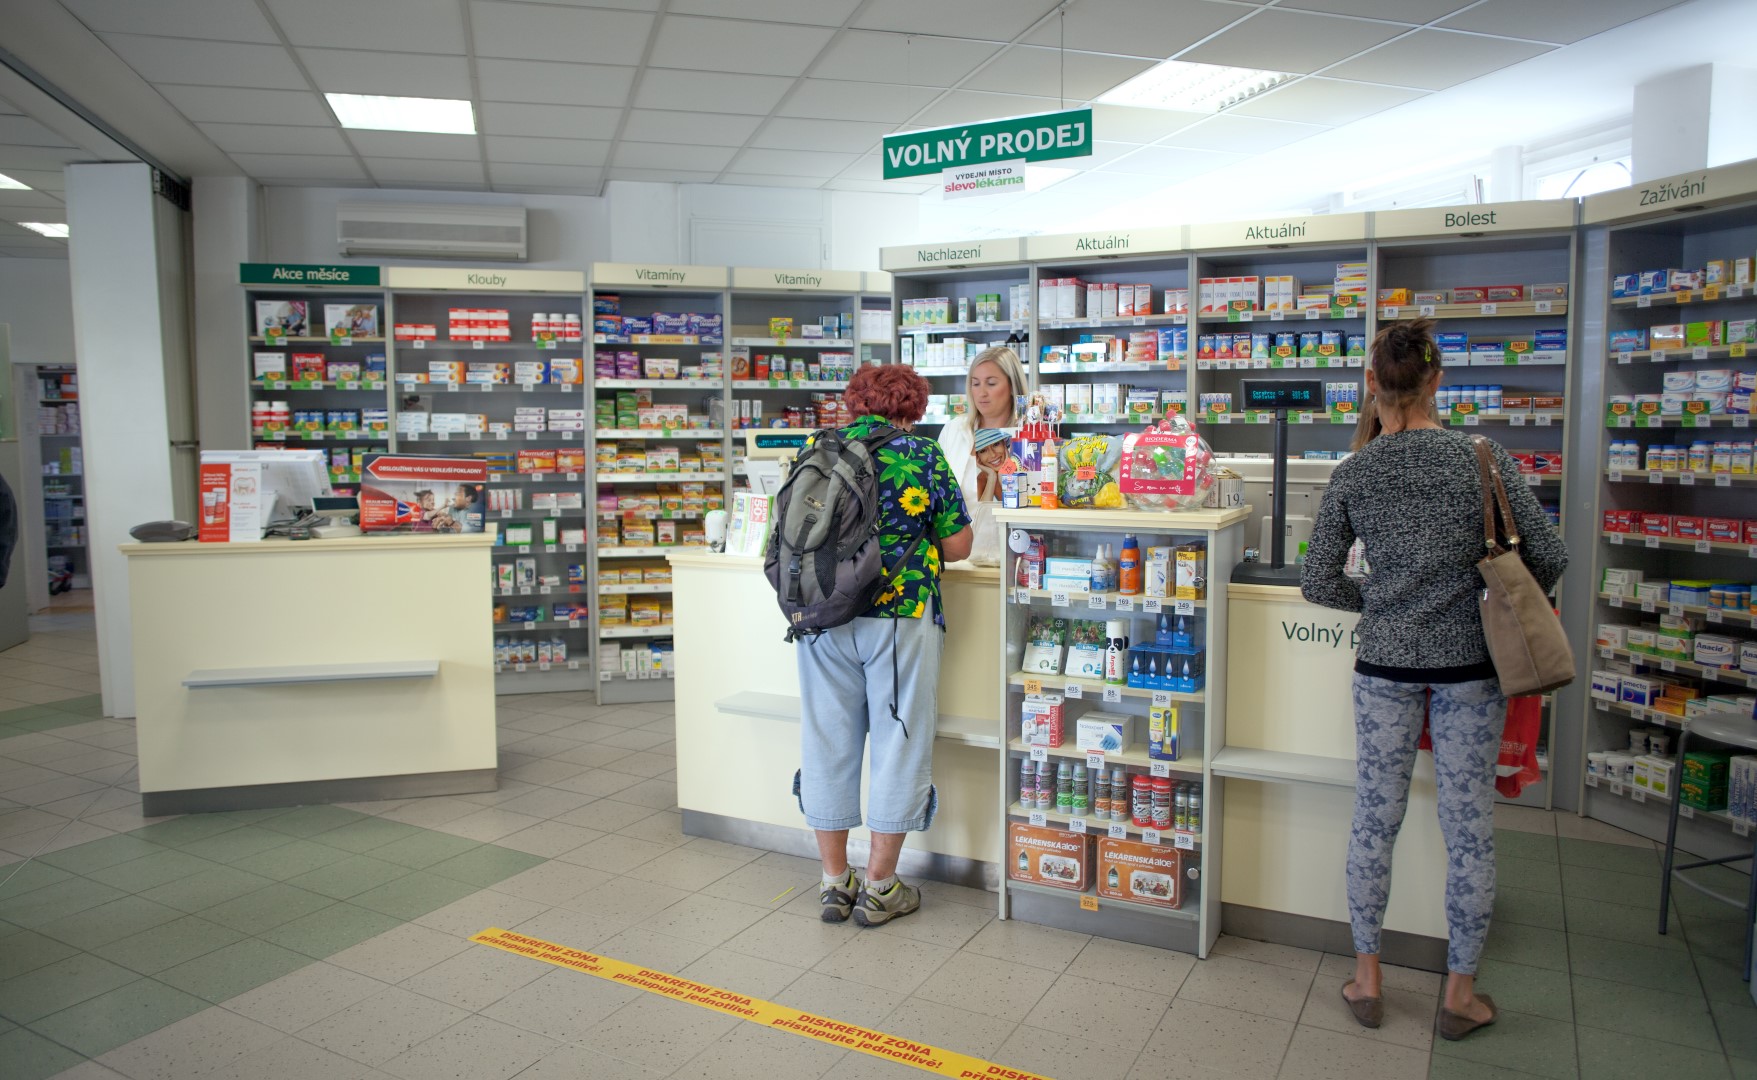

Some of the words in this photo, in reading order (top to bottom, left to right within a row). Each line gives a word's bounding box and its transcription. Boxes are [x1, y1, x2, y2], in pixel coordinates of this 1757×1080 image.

[888, 130, 973, 169] VOLNÝ
[980, 122, 1085, 157] PRODEJ
[945, 174, 1024, 193] slevolékárna
[955, 170, 987, 181] VÝDEJNÍ
[989, 167, 1012, 176] MÍSTO
[1639, 175, 1707, 206] Zažívání
[1444, 210, 1497, 228] Bolest
[1245, 221, 1306, 240] Aktuální
[1075, 234, 1130, 251] Aktuální
[917, 244, 982, 263] Nachlazení
[272, 267, 303, 281] Akce
[305, 267, 350, 281] měsíce
[467, 273, 507, 288] Klouby
[635, 268, 686, 284] Vitamíny
[774, 273, 822, 287] Vitamíny
[1281, 621, 1344, 649] Volný
[1695, 641, 1724, 653] Anacid
[1741, 650, 1757, 658] Ana
[1622, 679, 1647, 690] smecta
[476, 935, 539, 956] přístupujte
[499, 932, 563, 953] DISKRÉTNÍ
[561, 948, 600, 963] ZÓNA
[612, 973, 685, 996] přístupujte
[637, 970, 712, 994] DISKRÉTNÍ
[710, 990, 752, 1006] ZÓNA
[772, 1018, 856, 1045] přístupujte
[797, 1014, 884, 1042] DISKRÉTNÍ
[882, 1037, 931, 1056] ZÓNA
